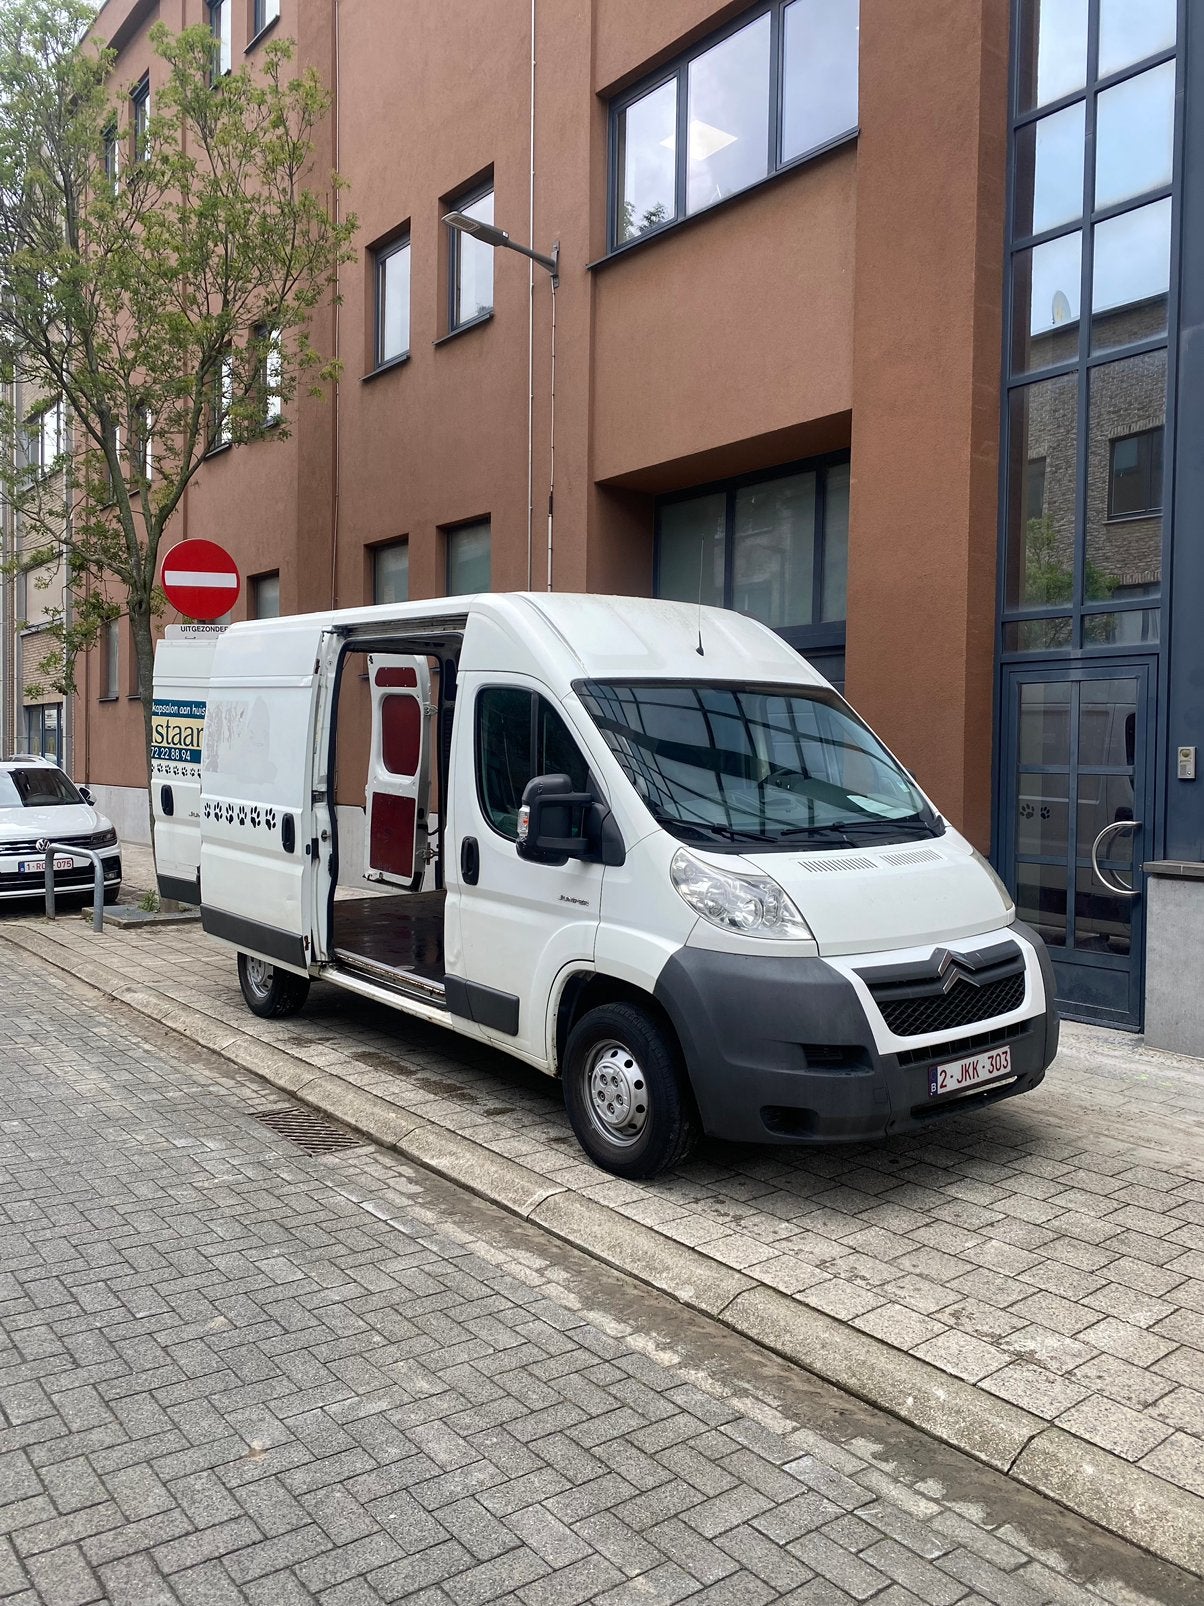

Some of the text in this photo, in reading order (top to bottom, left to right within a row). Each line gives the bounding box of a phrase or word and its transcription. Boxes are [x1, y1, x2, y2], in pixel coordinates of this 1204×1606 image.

[192, 704, 206, 716] huis
[152, 719, 204, 748] staar
[161, 748, 169, 759] 22
[171, 749, 180, 760] 88
[182, 750, 191, 761] 94
[930, 1082, 937, 1092] B
